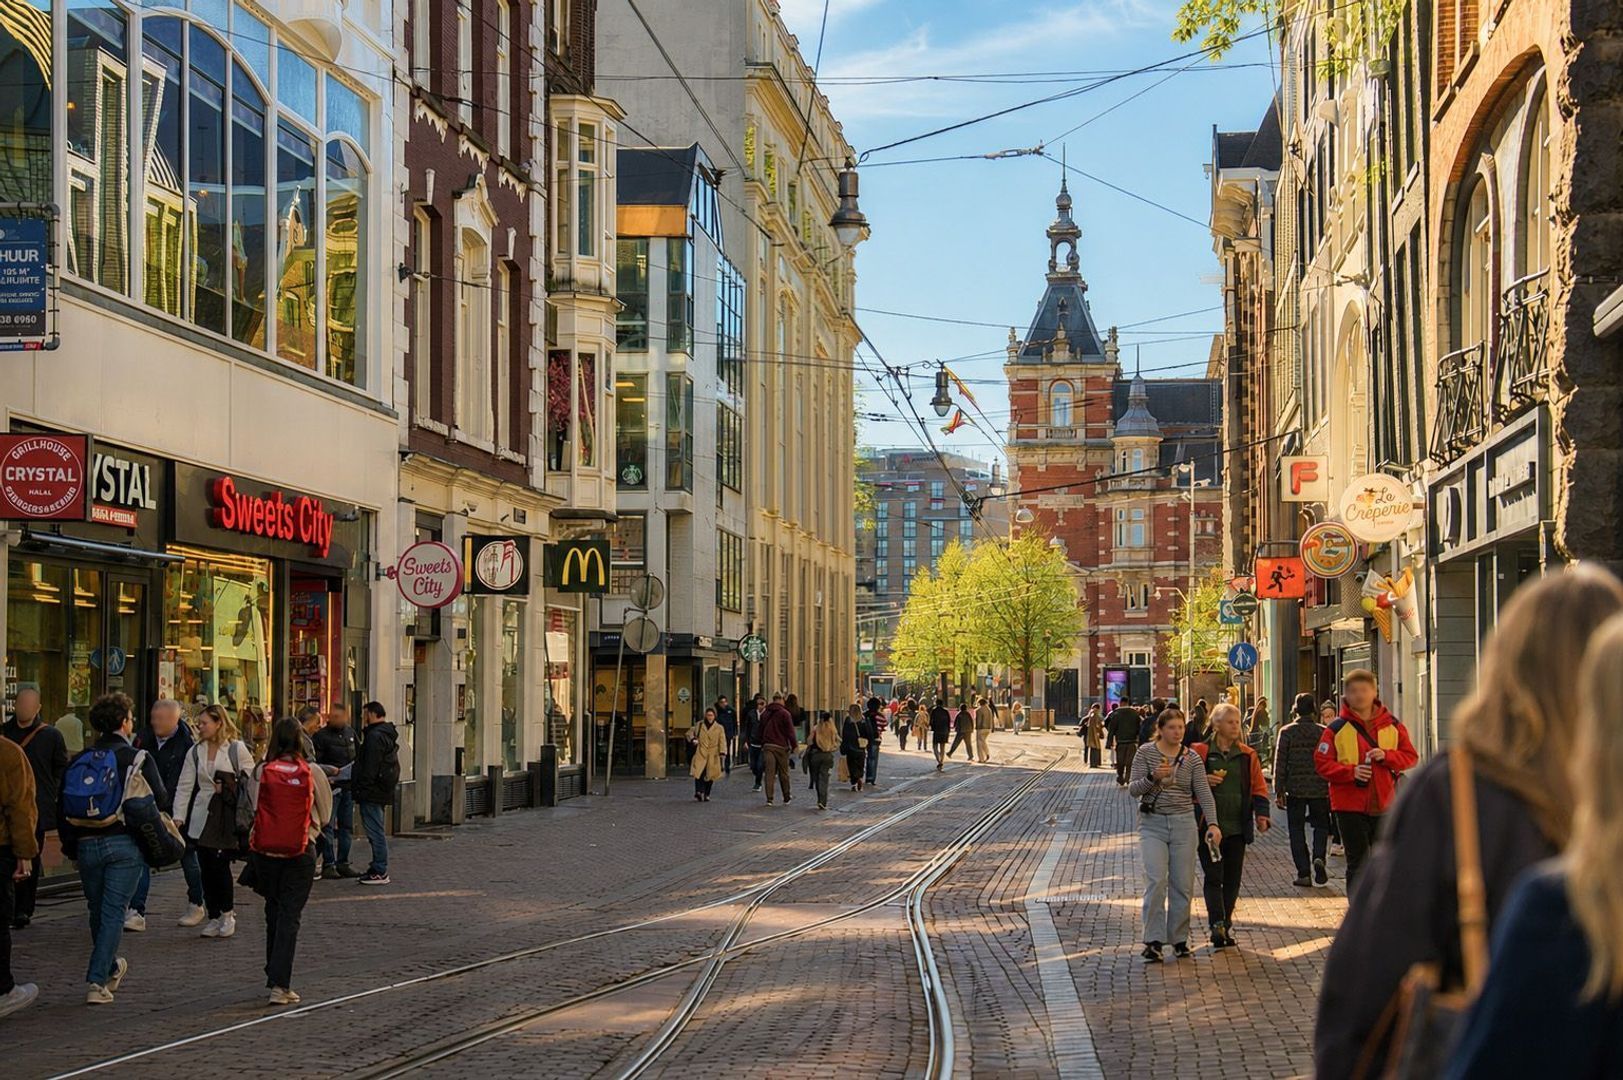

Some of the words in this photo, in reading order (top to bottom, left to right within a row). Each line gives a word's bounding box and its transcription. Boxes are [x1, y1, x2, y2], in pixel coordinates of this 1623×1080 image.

[11, 440, 72, 461] GRILLHOUSE
[5, 466, 77, 482] CRYSTAL
[1290, 461, 1318, 496] F
[216, 475, 295, 541] Sweets
[297, 495, 334, 559] City
[402, 557, 452, 576] Sweets
[413, 576, 444, 599] City
